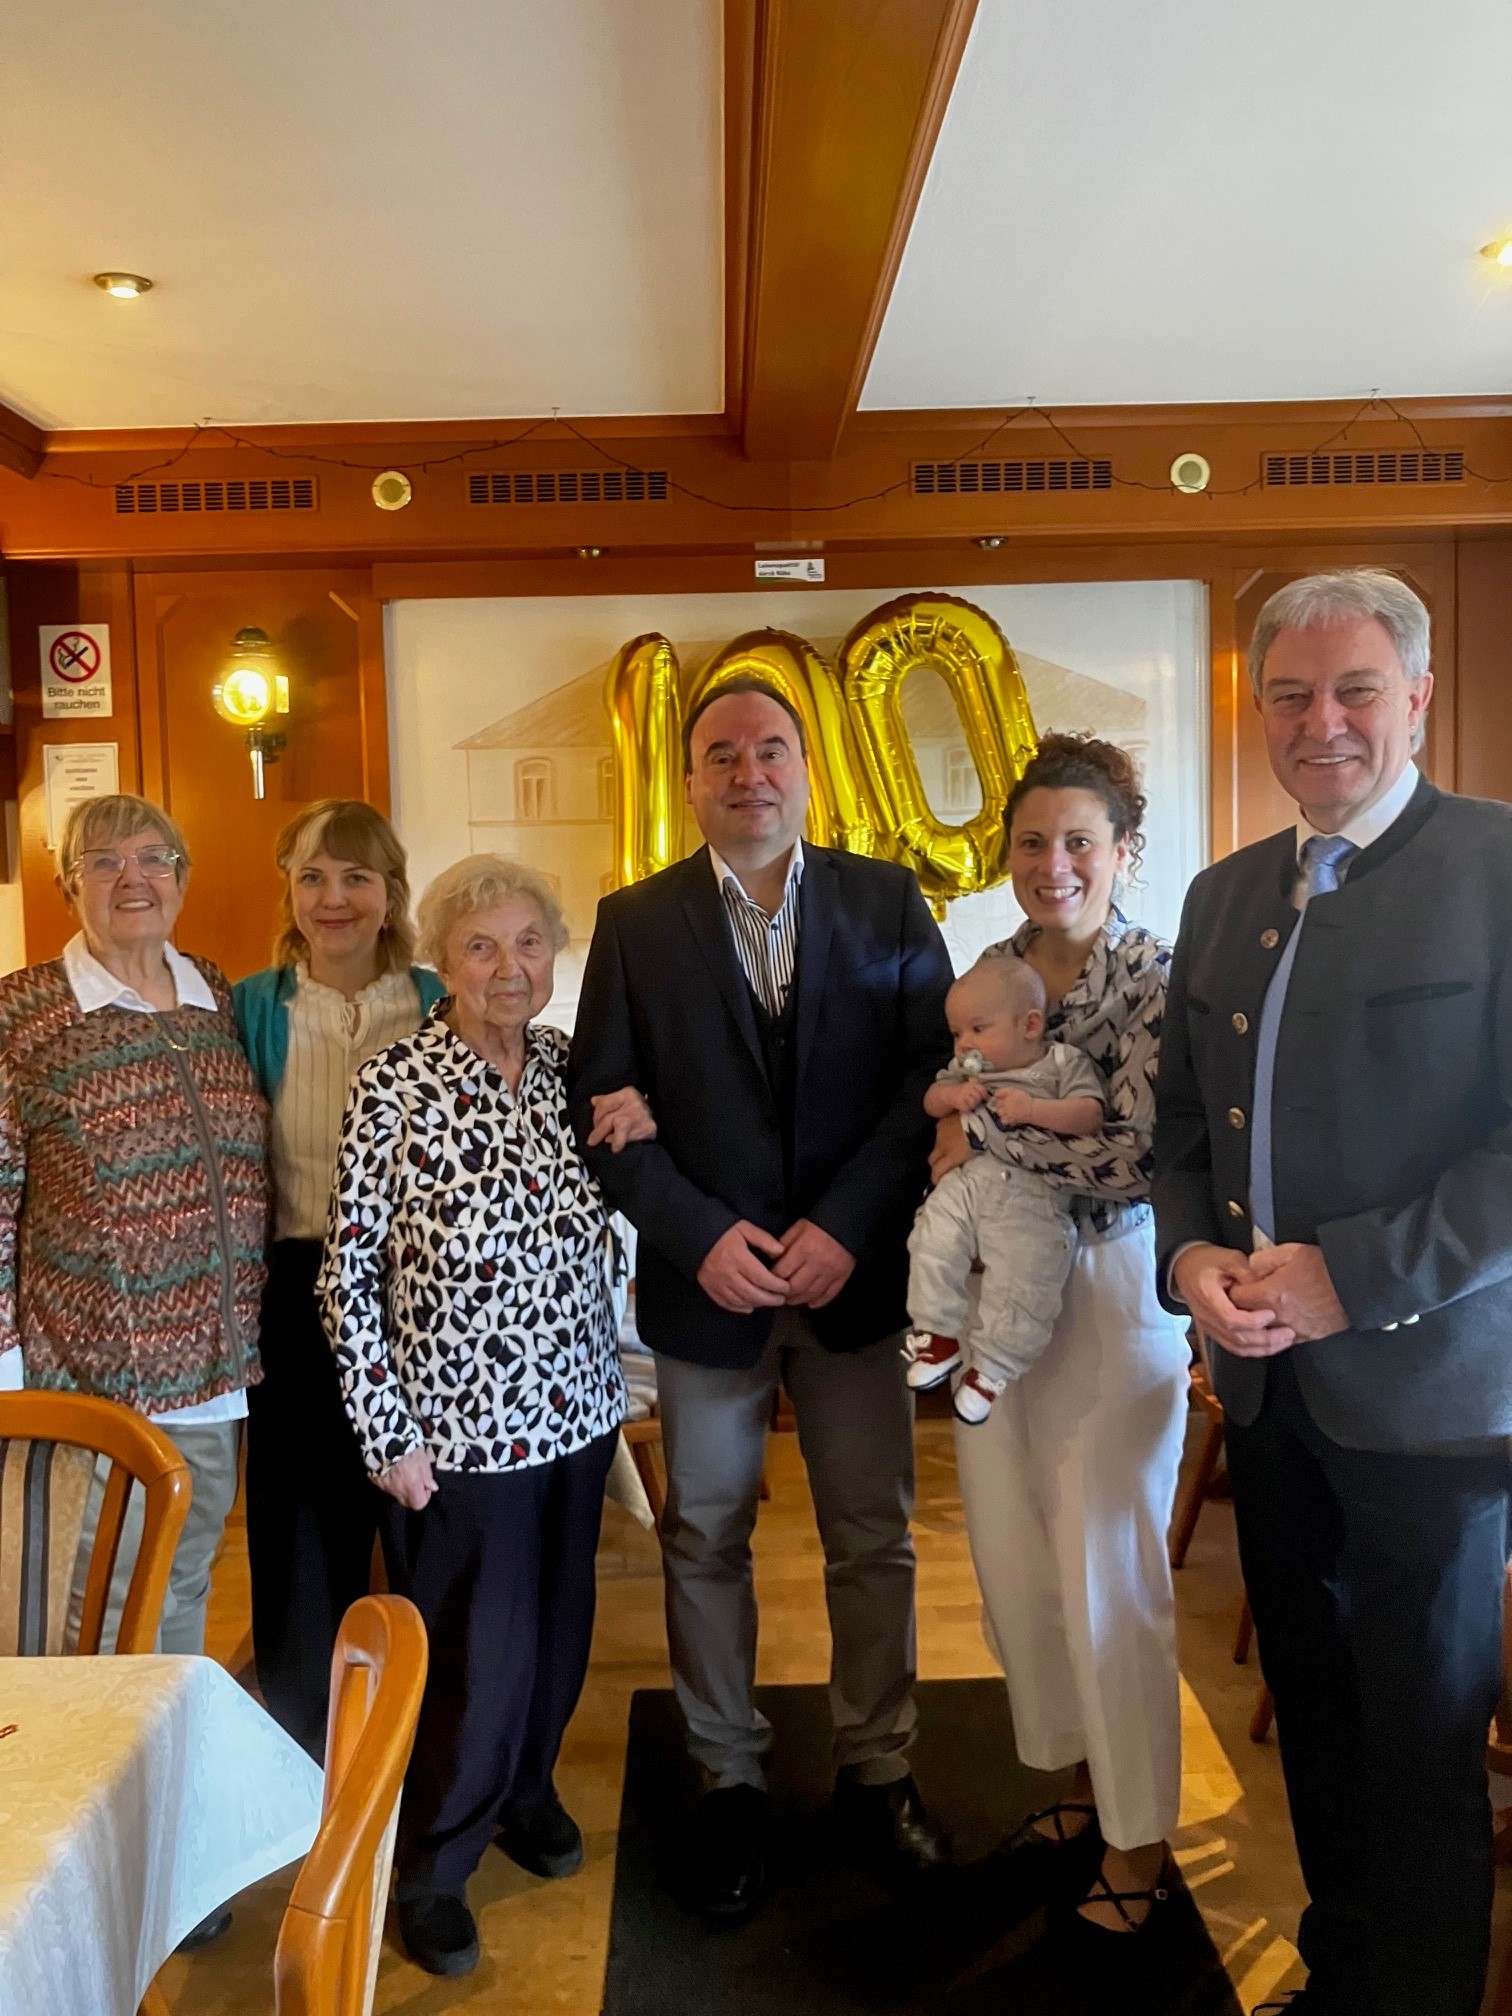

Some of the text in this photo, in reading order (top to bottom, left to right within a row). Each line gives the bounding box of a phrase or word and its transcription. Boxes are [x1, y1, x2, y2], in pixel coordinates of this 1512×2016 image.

[48, 687, 105, 697] Bitte nicht
[54, 700, 100, 709] rauchen
